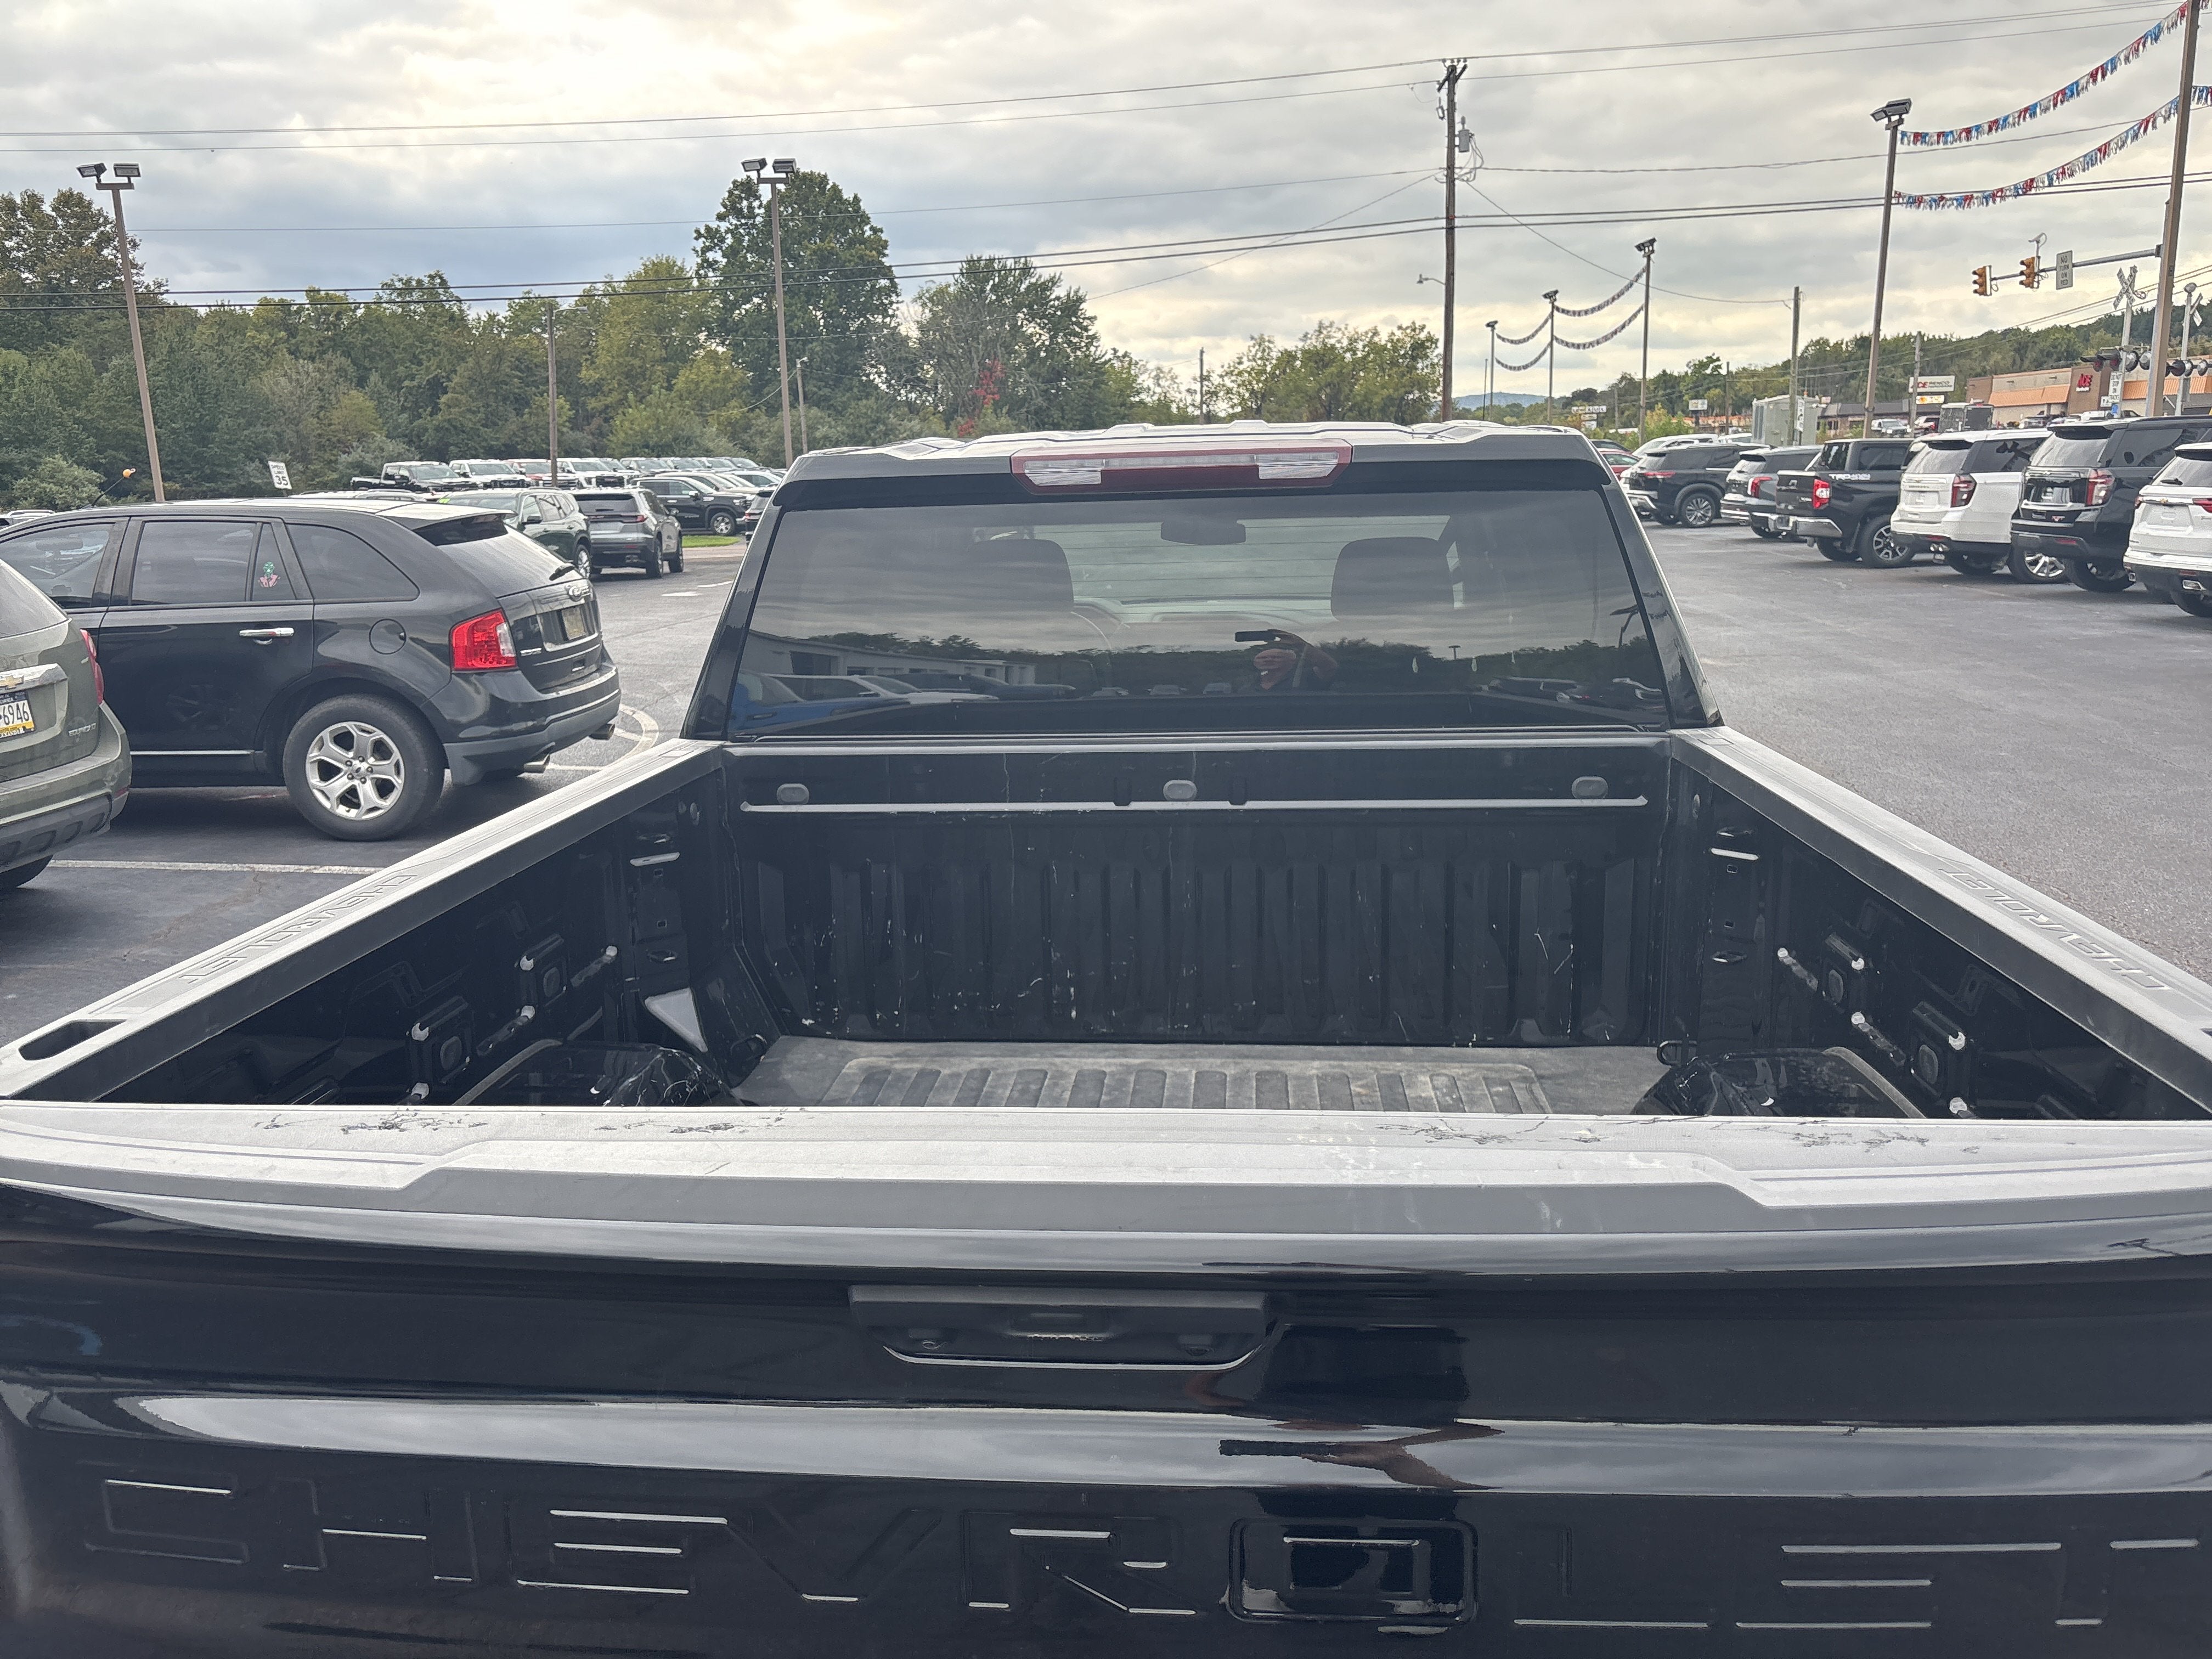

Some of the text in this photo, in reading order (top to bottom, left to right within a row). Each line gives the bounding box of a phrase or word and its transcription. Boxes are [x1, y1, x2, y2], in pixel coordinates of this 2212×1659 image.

[2060, 255, 2068, 264] NO
[2114, 266, 2138, 307] CROSSING
[275, 475, 289, 486] 35
[3, 702, 30, 726] 6946
[178, 874, 418, 984] CHEVROLET
[1938, 868, 2173, 990] CHEVROLET
[76, 1458, 2199, 1632] CHEVROLET
